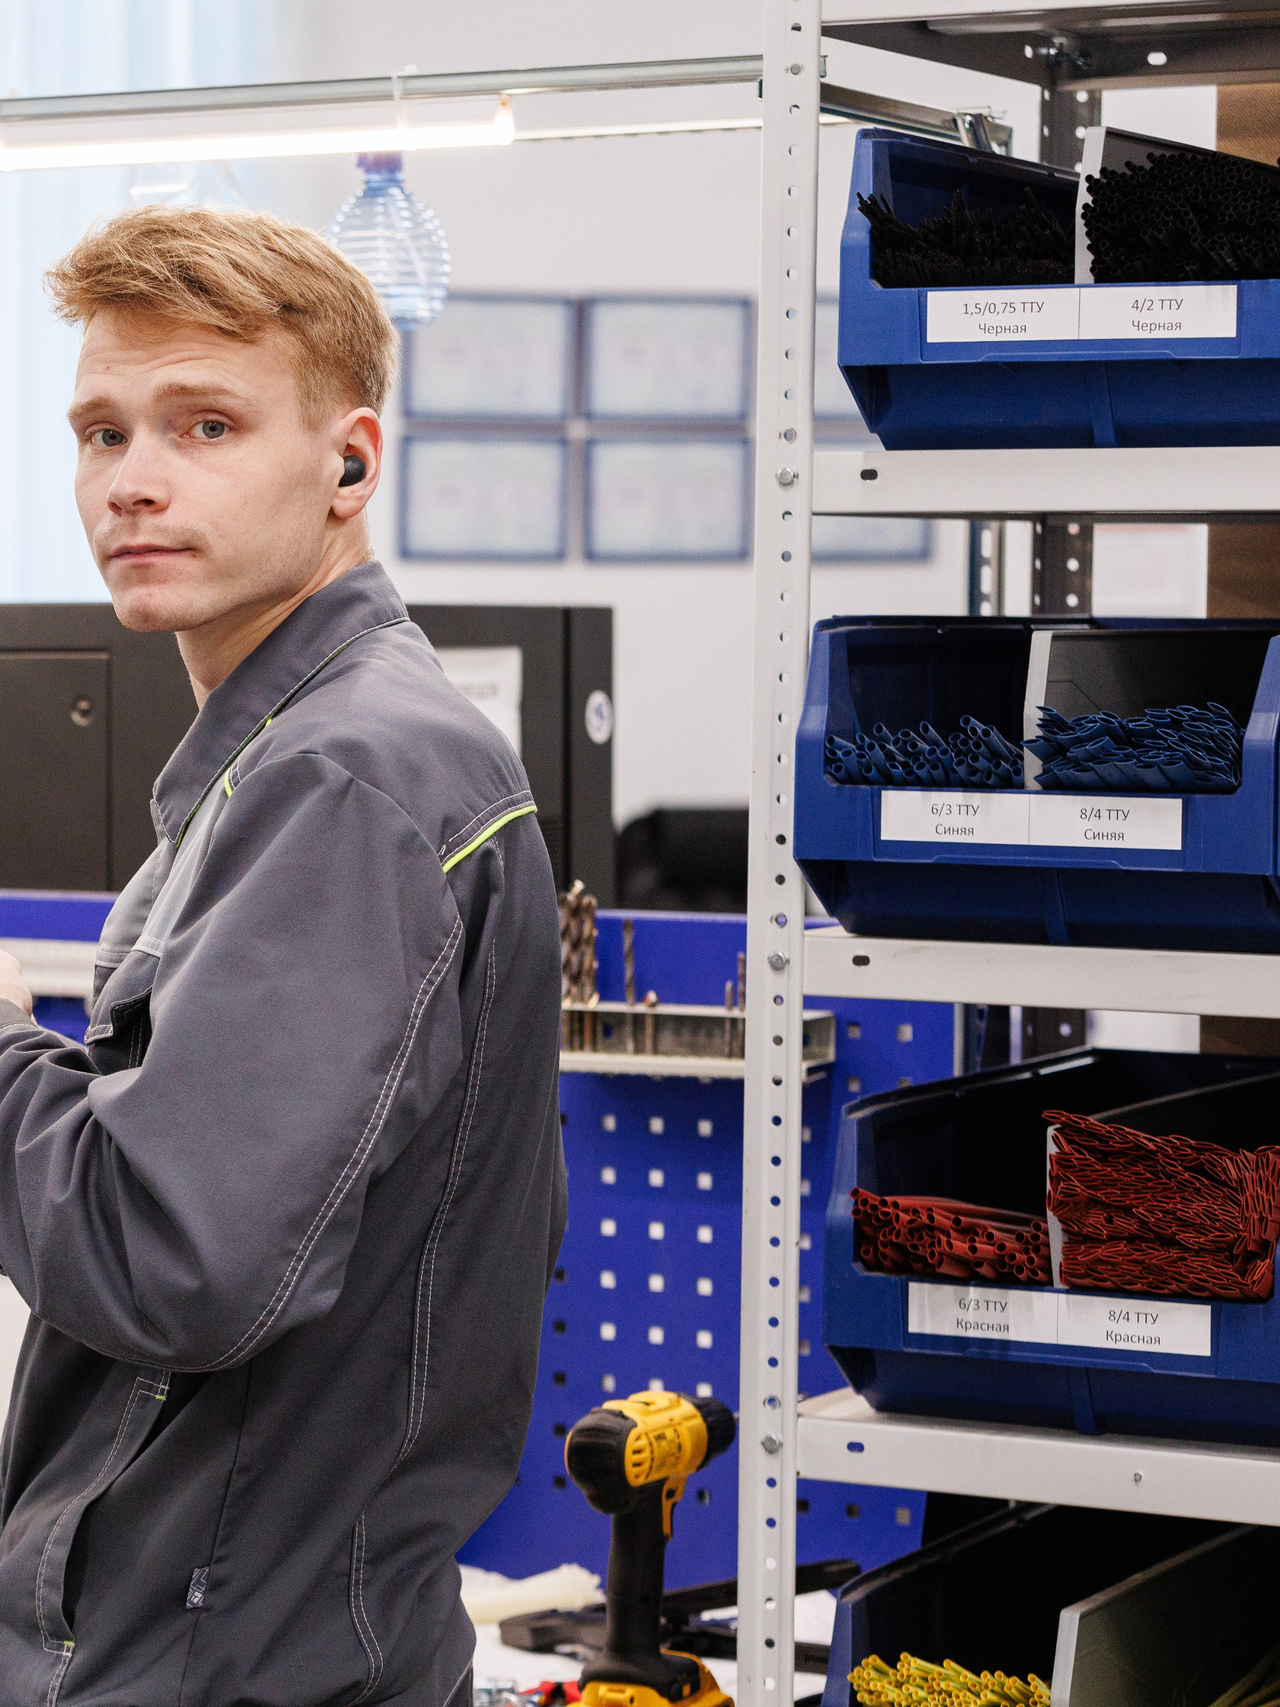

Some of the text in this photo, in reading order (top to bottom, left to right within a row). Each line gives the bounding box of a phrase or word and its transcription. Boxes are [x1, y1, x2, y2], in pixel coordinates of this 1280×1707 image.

[963, 301, 1045, 316] 1,5/0,75 ТТУ
[1131, 298, 1184, 313] 4/2 ТТУ
[978, 323, 1027, 337] Черная
[1132, 320, 1182, 334] Черная
[931, 803, 980, 817] 6/3 ТТУ
[1080, 807, 1130, 822] 8/4 ТТУ
[935, 824, 974, 836] Синяя
[1084, 828, 1125, 841] Синяя
[958, 1296, 1008, 1313] 6/3 ТТУ
[1108, 1309, 1159, 1325] 8/4 ТТУ
[956, 1318, 1009, 1333] Красная
[1106, 1330, 1161, 1345] Красная
